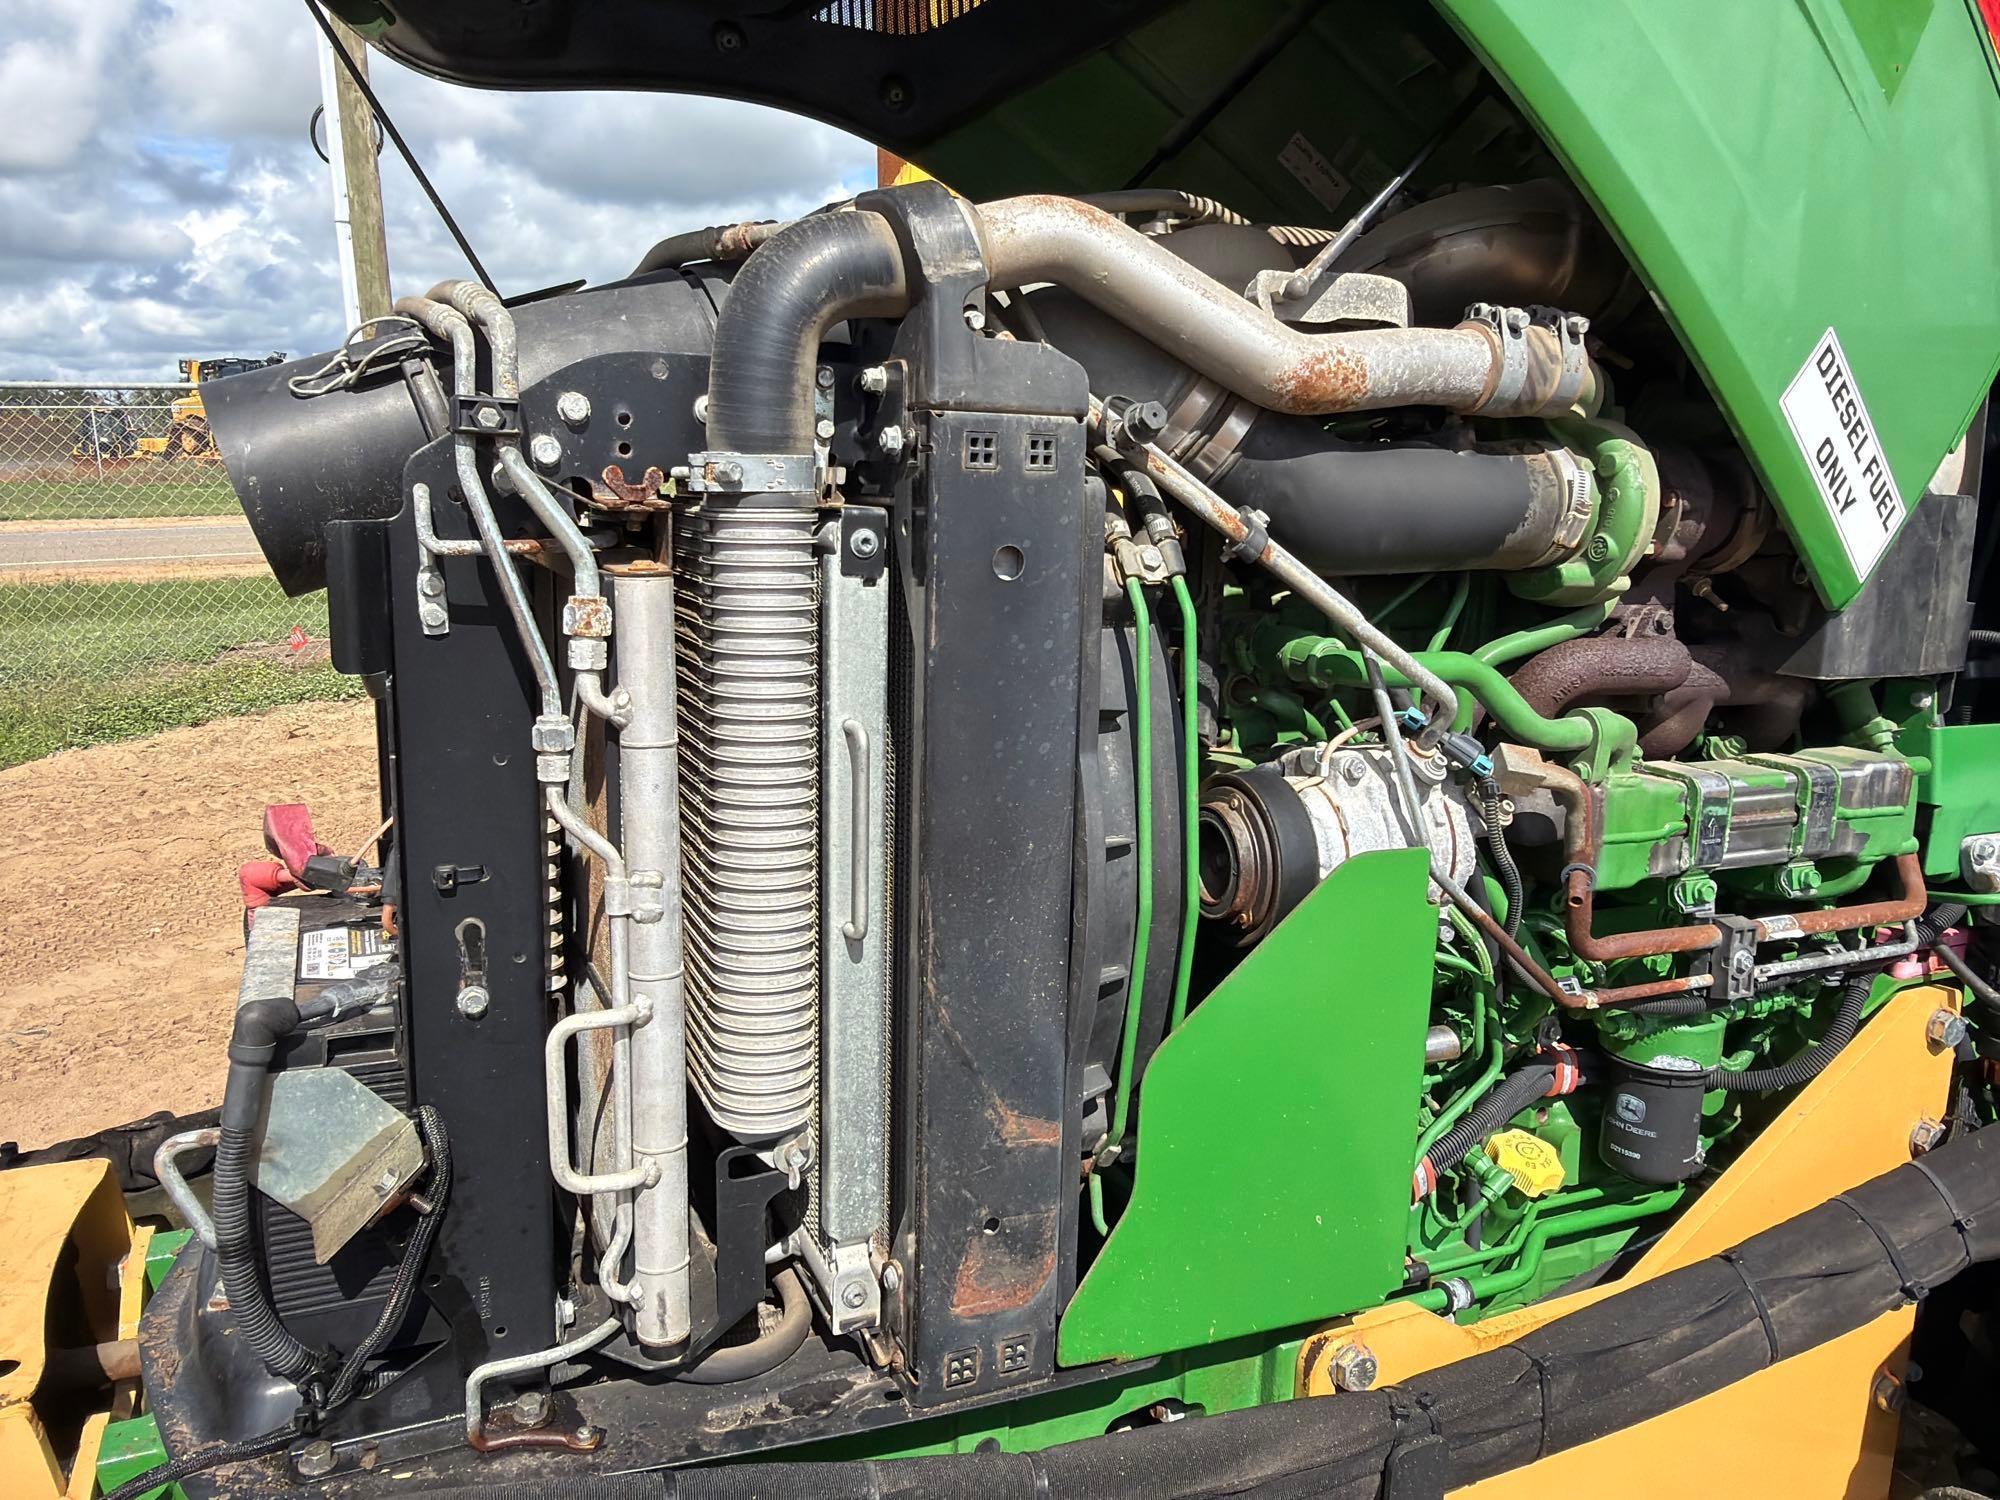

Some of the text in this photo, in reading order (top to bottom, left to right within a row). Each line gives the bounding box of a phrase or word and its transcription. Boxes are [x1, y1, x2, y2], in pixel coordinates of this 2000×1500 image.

[1816, 343, 1897, 533] DIESEL FUEL
[1816, 437, 1857, 516] ONLY
[1625, 1123, 1657, 1138] DEERE
